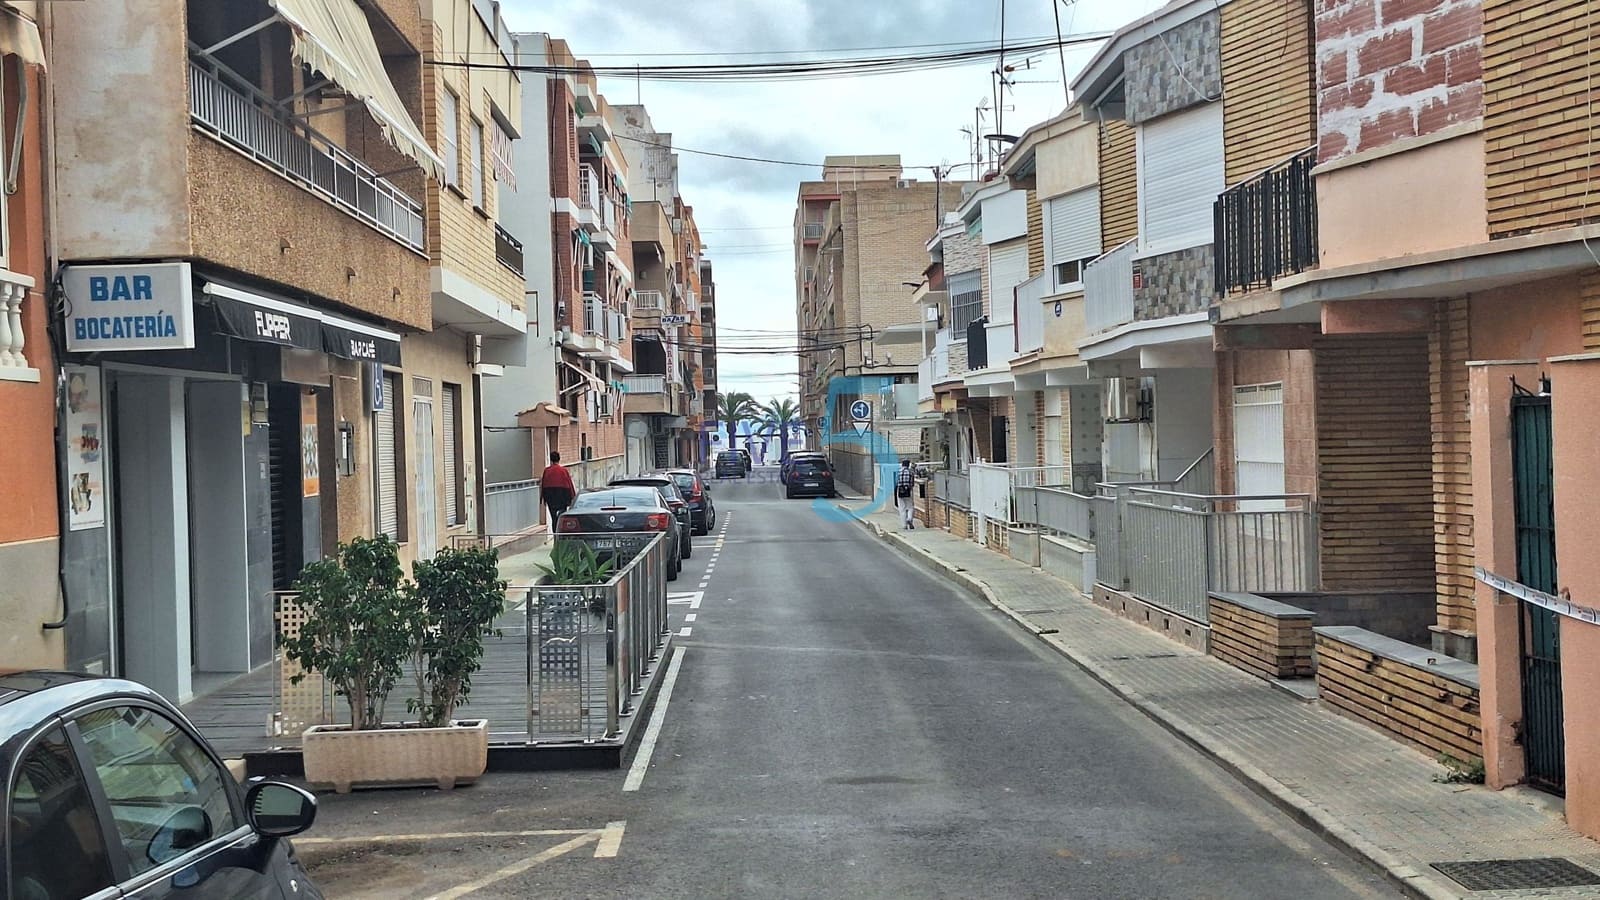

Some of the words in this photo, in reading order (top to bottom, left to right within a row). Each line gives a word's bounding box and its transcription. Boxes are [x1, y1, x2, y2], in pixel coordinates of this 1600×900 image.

[90, 275, 152, 301] BAR
[75, 309, 177, 340] BOCATERÍA
[254, 311, 292, 340] FLIPPER
